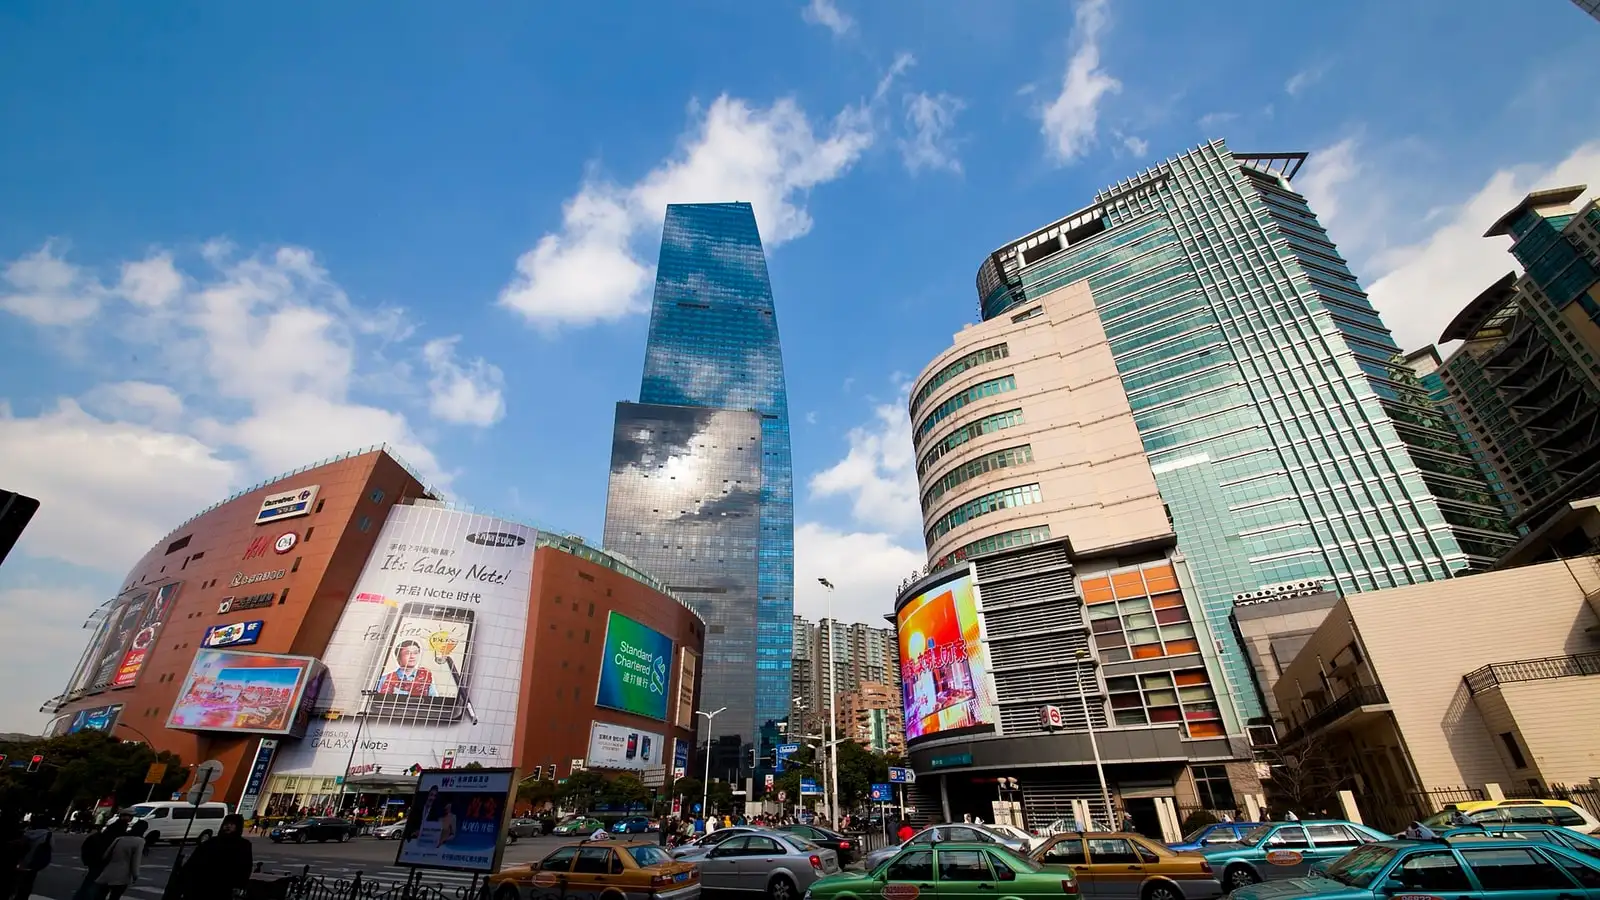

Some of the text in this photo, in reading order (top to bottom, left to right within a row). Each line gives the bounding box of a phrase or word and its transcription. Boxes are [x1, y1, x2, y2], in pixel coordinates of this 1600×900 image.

[381, 553, 512, 585] It's Galaxy Note!
[396, 584, 481, 604] 开启 Note 时代
[620, 641, 653, 663] Standard
[614, 653, 651, 675] Chartered
[622, 671, 649, 689] 渣打银行
[360, 740, 389, 751] Note
[457, 744, 499, 756] 智慧人生
